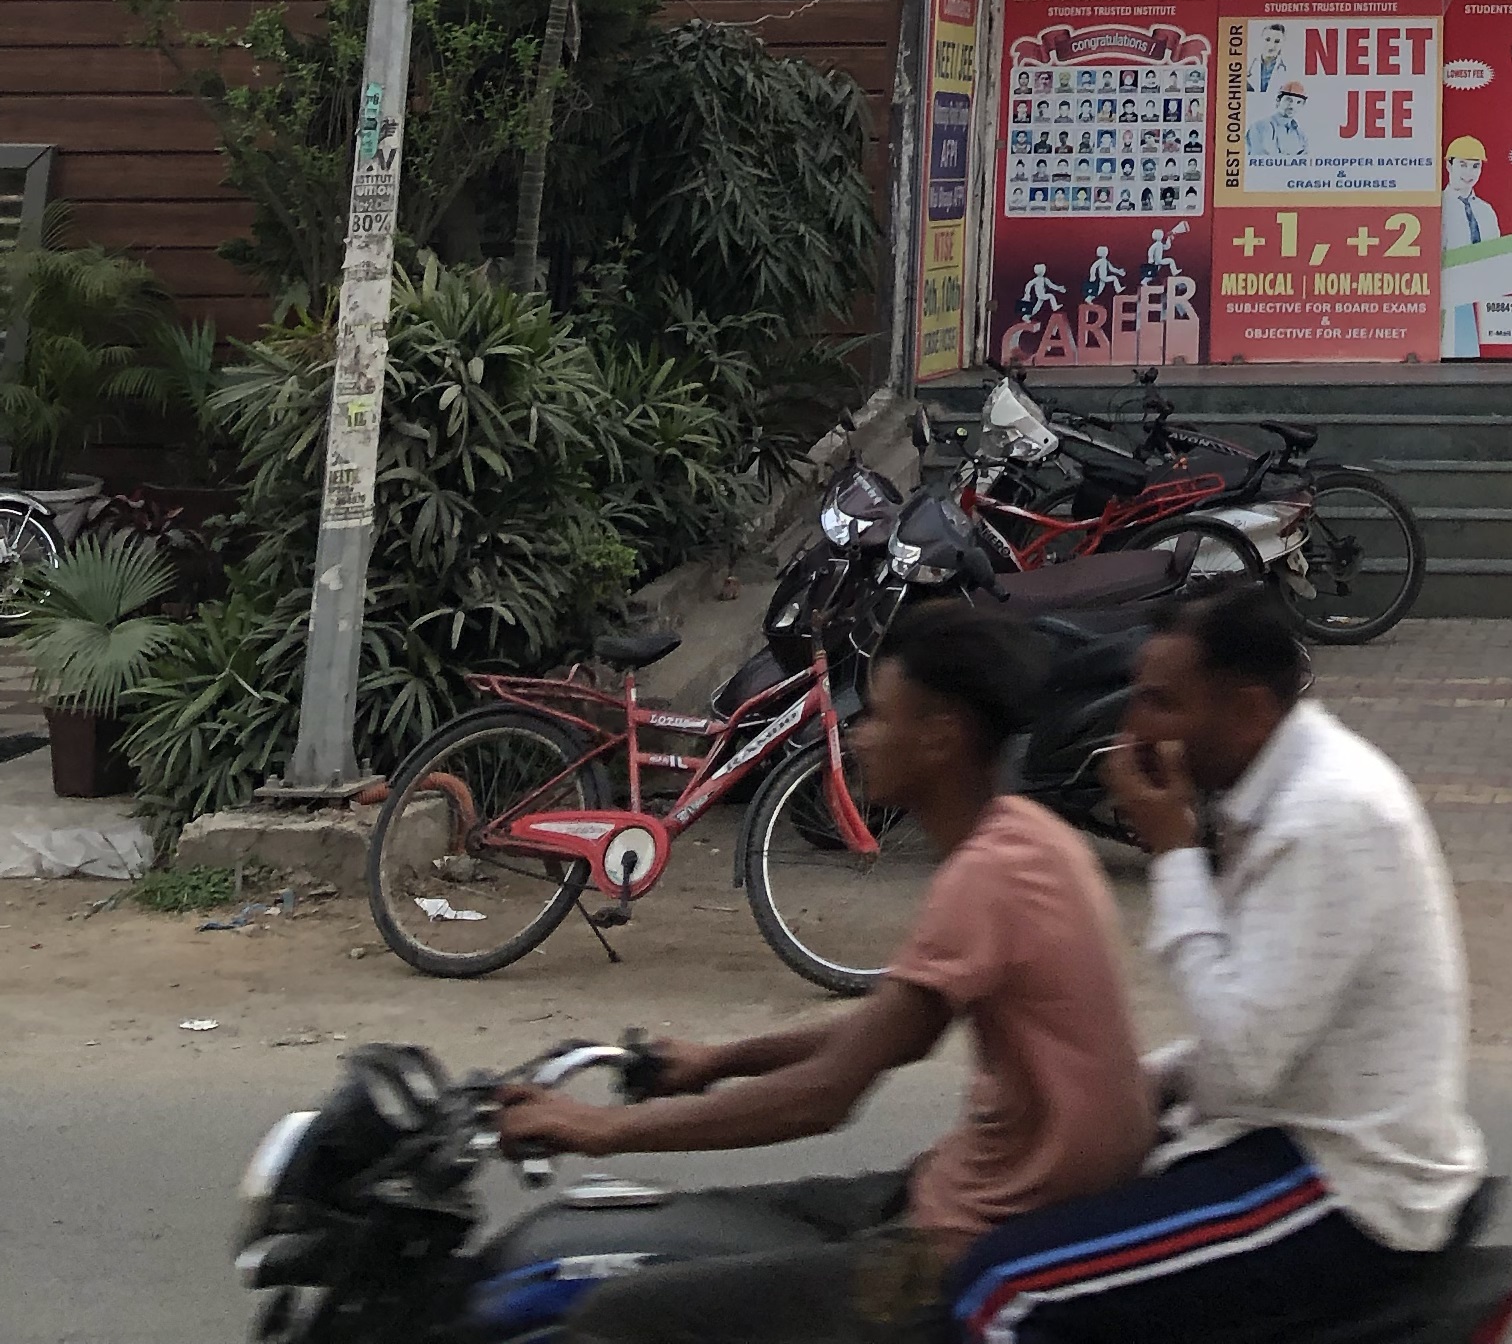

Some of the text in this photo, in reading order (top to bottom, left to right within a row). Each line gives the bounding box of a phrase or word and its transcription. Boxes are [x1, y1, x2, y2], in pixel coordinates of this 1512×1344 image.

[1047, 6, 1176, 16] STUDENTS TRUSTED INSTITUTE
[1264, 2, 1398, 13] STUDENTS TRUSTED INSTITUTE
[1304, 27, 1433, 76] NEET
[1225, 24, 1243, 188] BEST COACHING FOR
[1339, 90, 1414, 139] JEE
[1249, 157, 1434, 167] REGULAR DROPPER BATCHES
[1286, 179, 1397, 189] CRASH COURSES
[1346, 212, 1421, 258] +2
[1221, 272, 1431, 296] MEDICAL NON-MEDICAL
[1226, 302, 1427, 313] SUBJECTIVE FOR BOARD EXAMS
[1001, 275, 1200, 365] CAREER
[1244, 328, 1312, 339] OBJECTIVE
[1316, 328, 1341, 339] FOR
